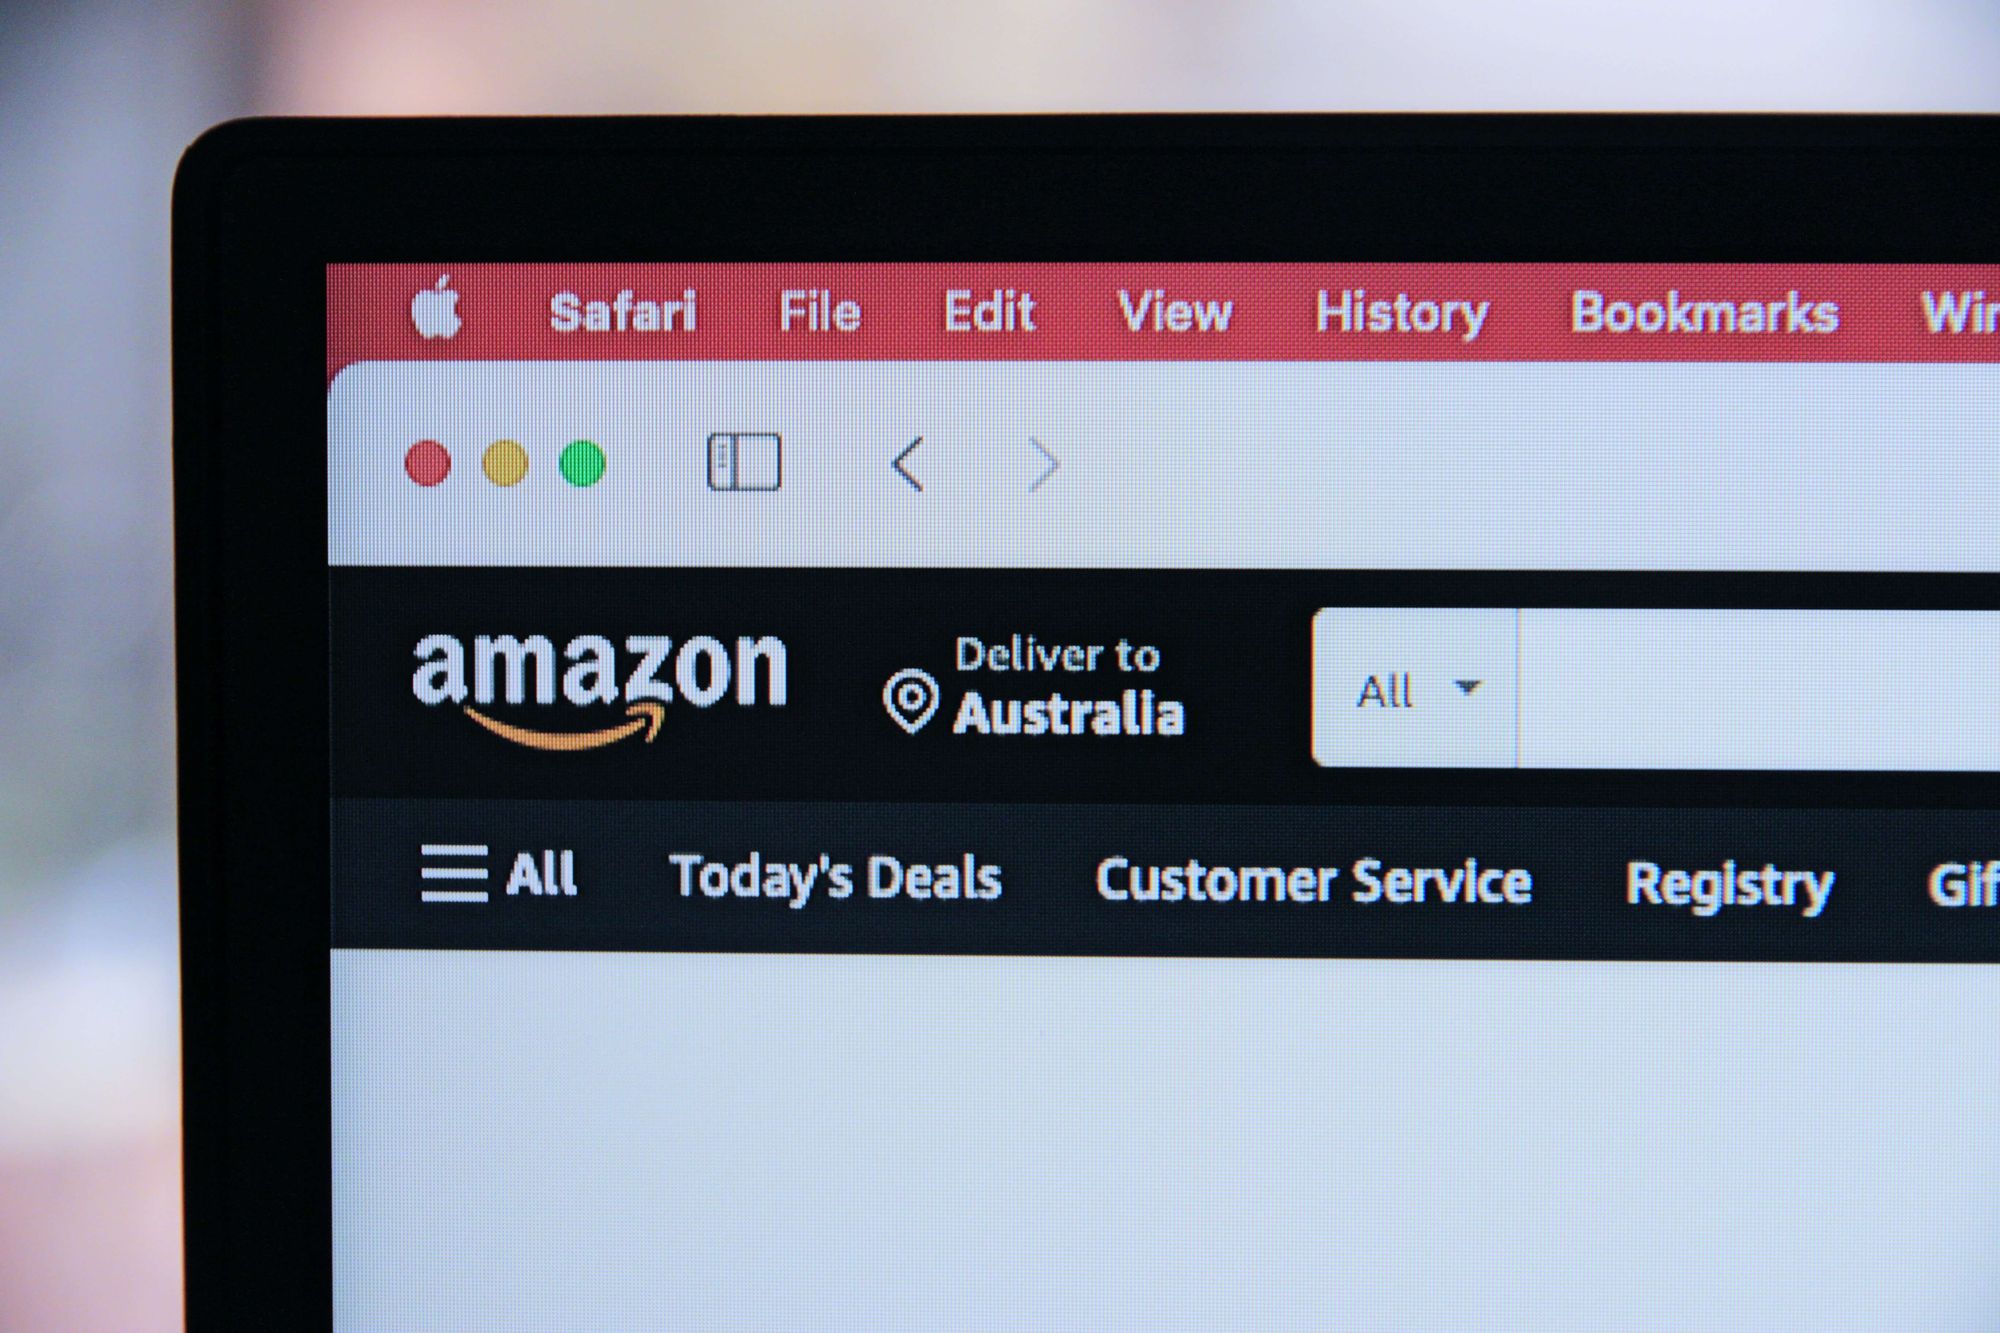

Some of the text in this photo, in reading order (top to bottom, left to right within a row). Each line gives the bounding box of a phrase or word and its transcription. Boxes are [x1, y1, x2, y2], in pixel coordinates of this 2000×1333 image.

[550, 288, 696, 333] Safari
[780, 288, 861, 333] File
[945, 288, 1037, 332] Edit
[1117, 288, 1233, 333] View
[1317, 288, 1490, 343] History
[1572, 289, 1839, 334] Bookmarks
[412, 634, 787, 706] amazon
[956, 633, 1161, 673] Deliver to
[952, 688, 1185, 736] Australia
[1356, 672, 1413, 709] All
[505, 849, 578, 896] All
[668, 851, 1003, 910] Today's Deals
[1097, 855, 1532, 905] Customer Service
[1628, 859, 1835, 918] Registry
